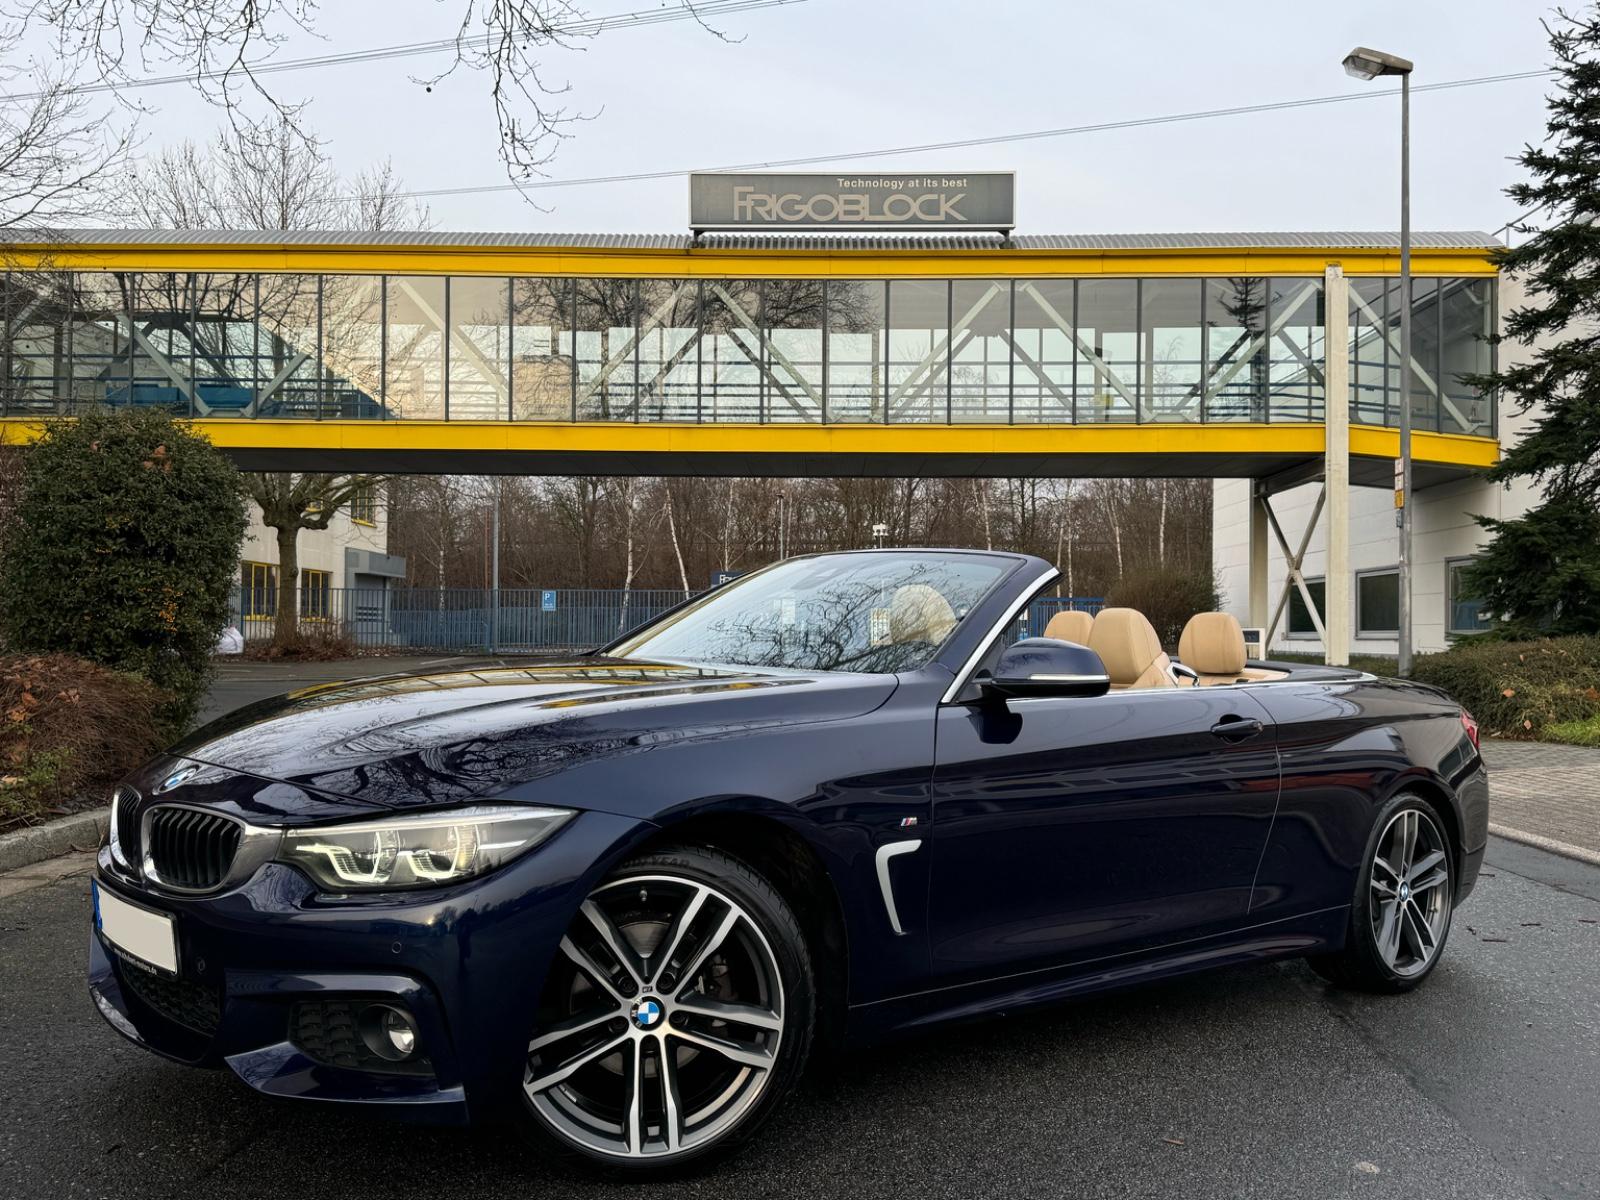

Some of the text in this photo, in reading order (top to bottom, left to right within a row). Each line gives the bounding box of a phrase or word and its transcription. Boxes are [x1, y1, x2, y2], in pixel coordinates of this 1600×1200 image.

[837, 178, 968, 190] Technology at its best
[733, 186, 968, 221] FRIGOBLOCK
